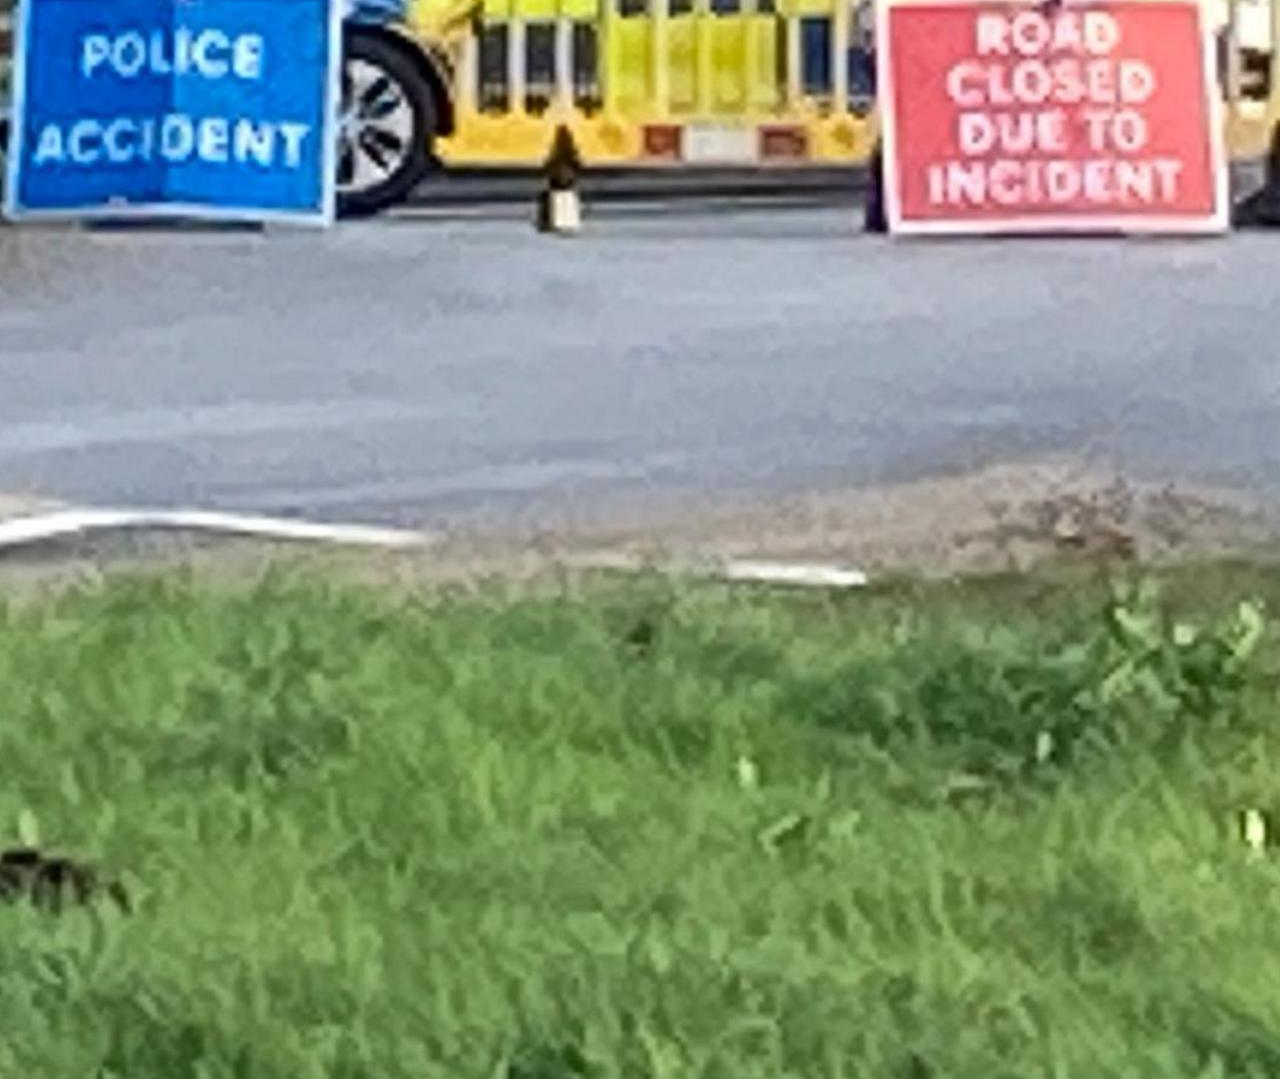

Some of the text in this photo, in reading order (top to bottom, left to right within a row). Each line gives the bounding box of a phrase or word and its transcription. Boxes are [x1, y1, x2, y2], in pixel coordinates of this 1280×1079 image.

[82, 28, 264, 78] POLICE
[976, 10, 1122, 56] ROAD
[946, 58, 1156, 104] CLOSED
[34, 115, 310, 166] ACCIDENT
[958, 107, 1148, 154] DUE TO
[927, 157, 1184, 204] INCIDENT
